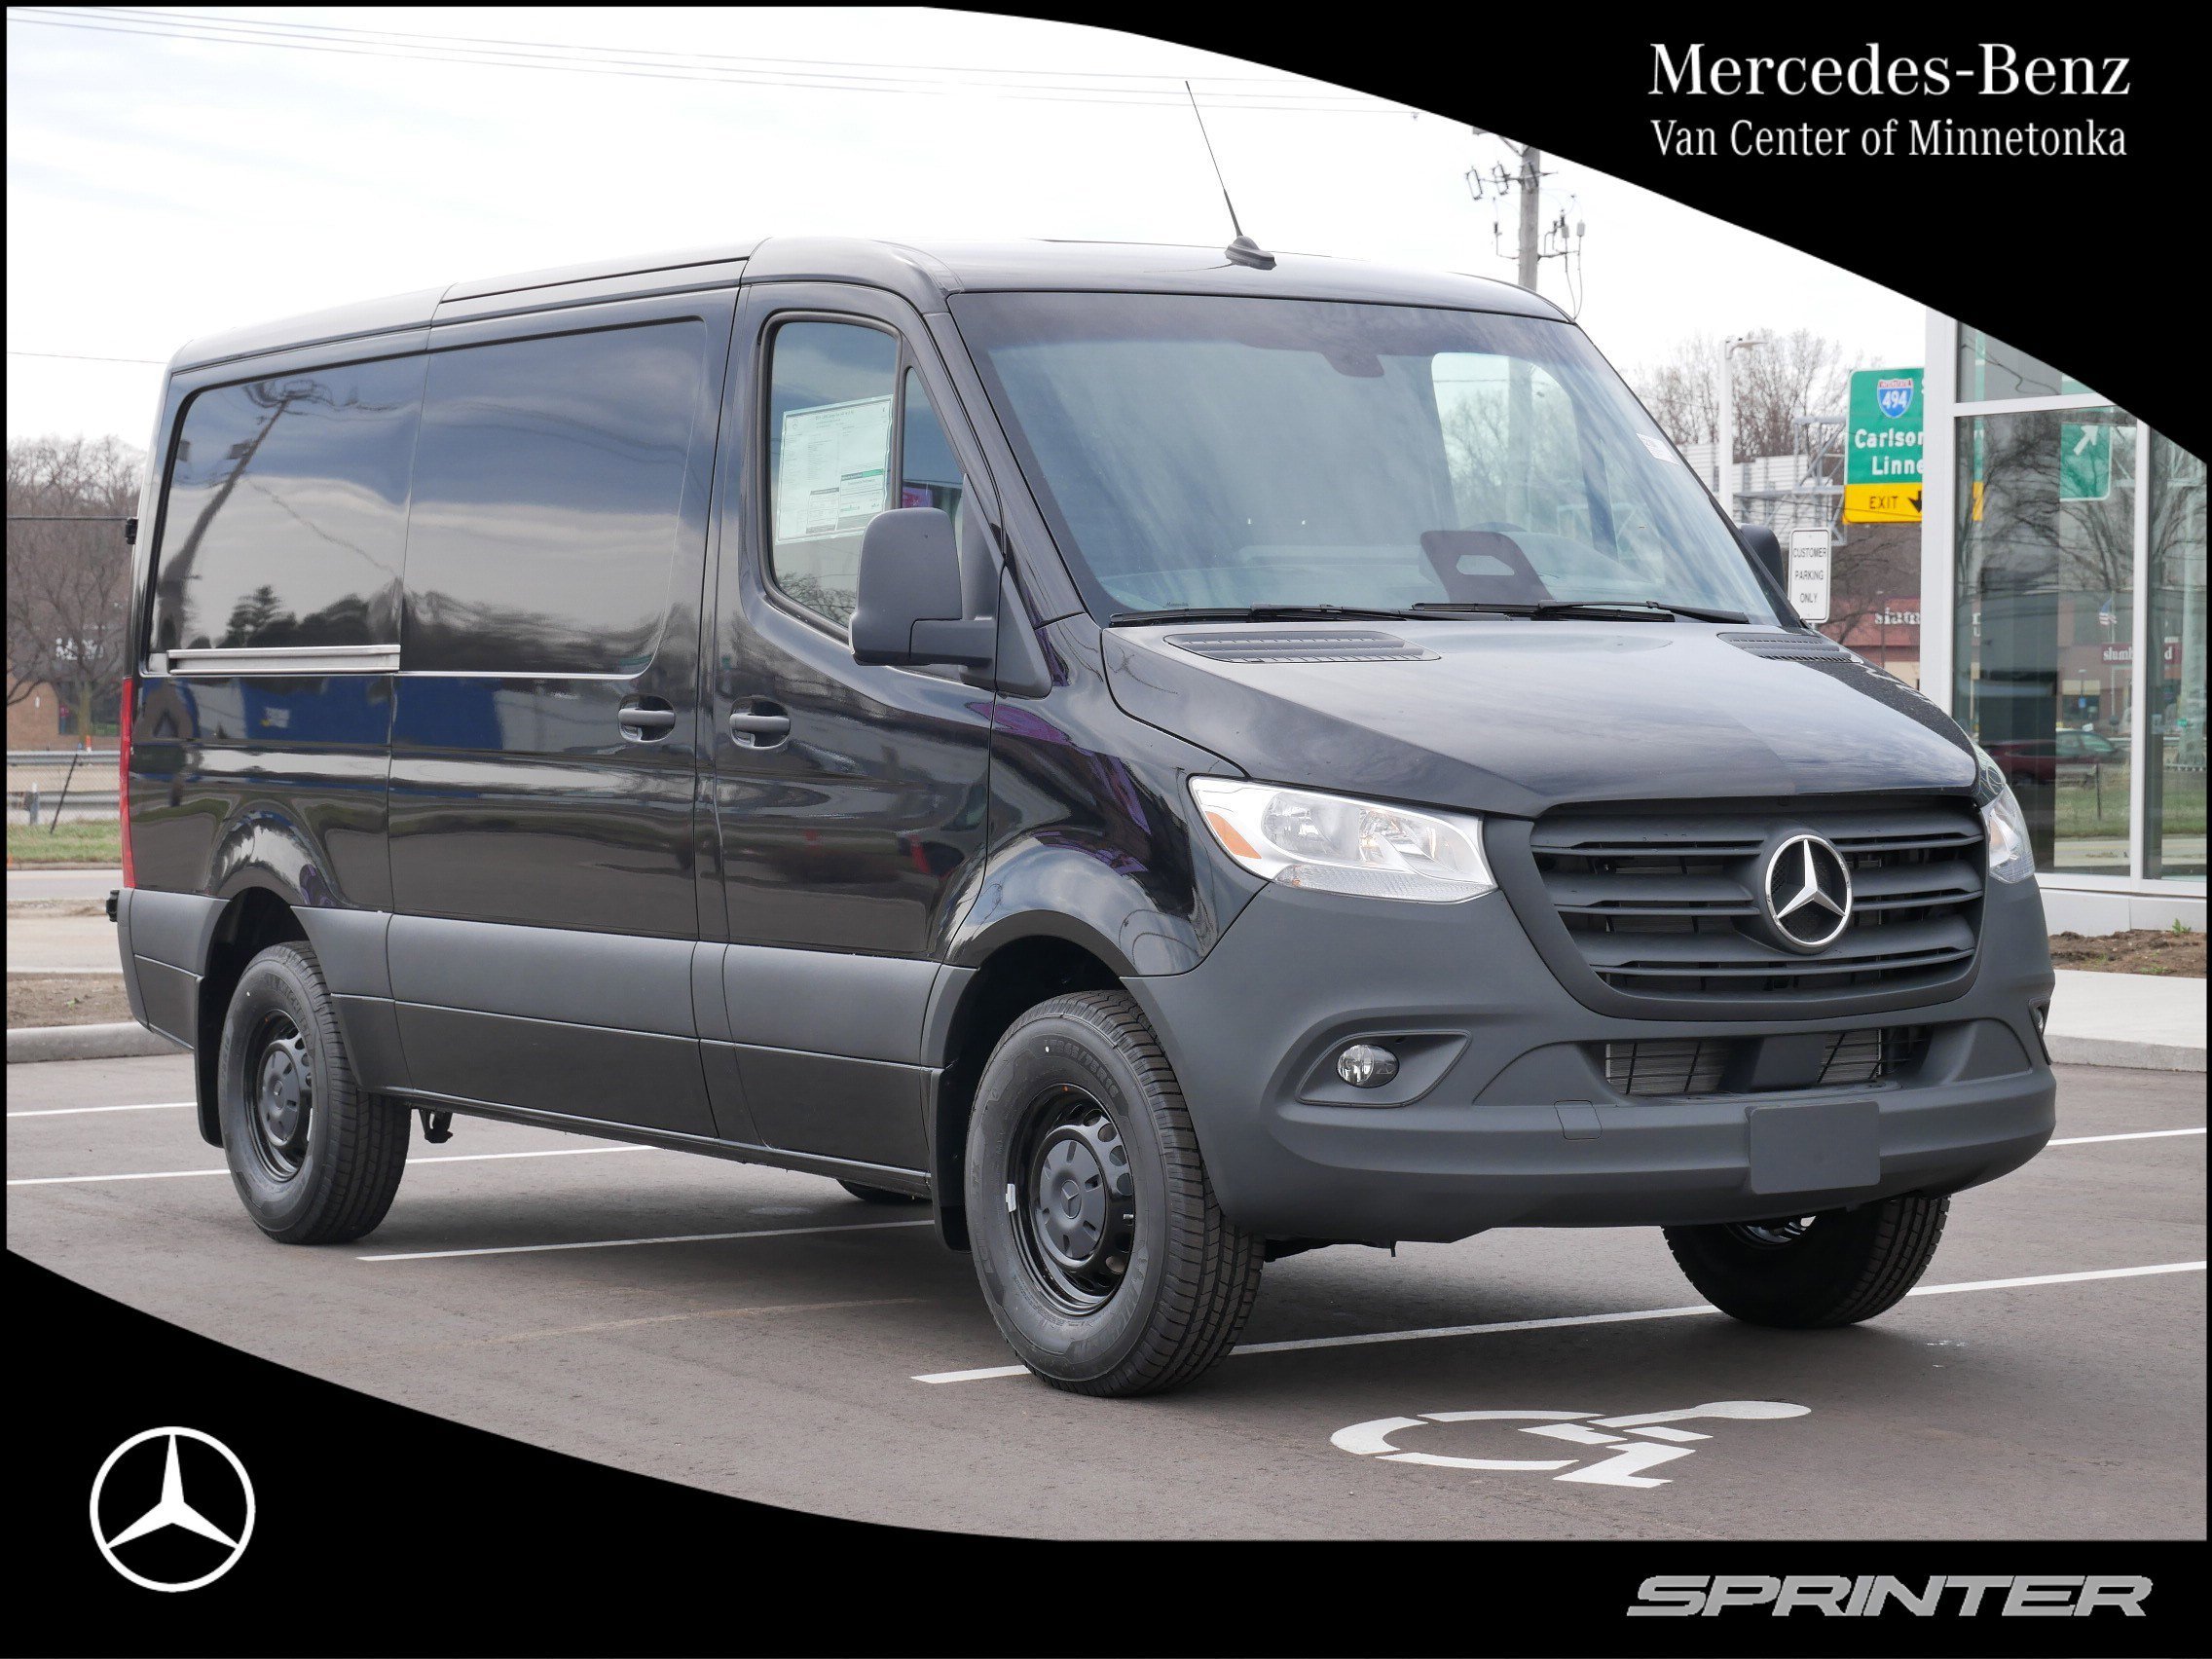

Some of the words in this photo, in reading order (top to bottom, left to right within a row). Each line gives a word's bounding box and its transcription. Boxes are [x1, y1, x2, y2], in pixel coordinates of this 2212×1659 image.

[1882, 389, 1907, 409] 494
[1869, 496, 1899, 509] EXIT
[1792, 547, 1826, 558] CUSTOMER
[1794, 570, 1824, 580] PARKING
[1799, 592, 1818, 604] ONLY
